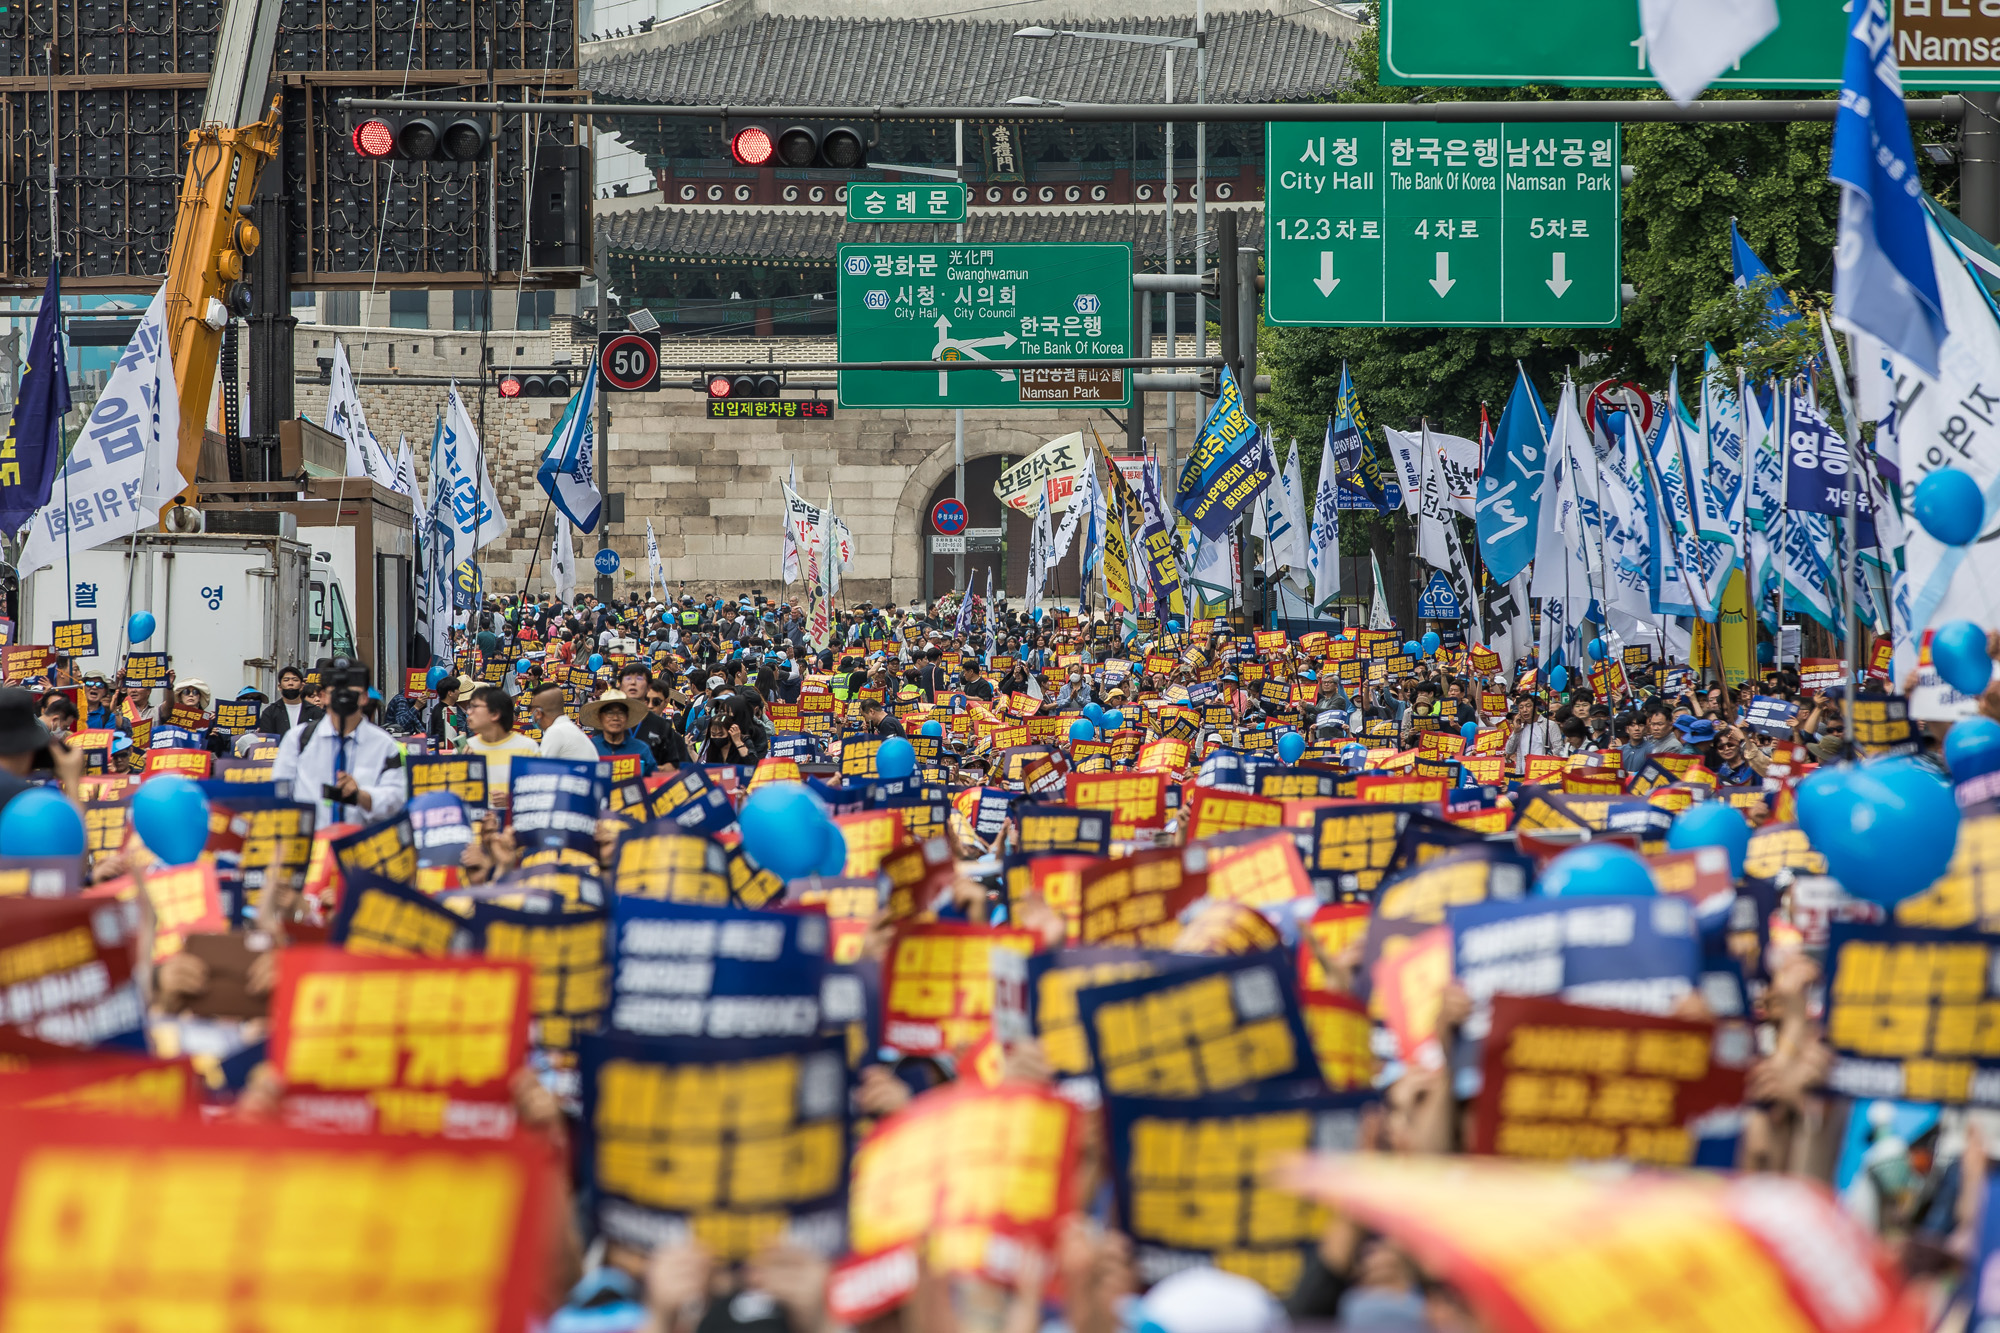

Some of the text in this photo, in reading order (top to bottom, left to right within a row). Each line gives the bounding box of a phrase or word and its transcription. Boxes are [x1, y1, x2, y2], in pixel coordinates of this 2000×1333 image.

[992, 125, 1014, 172] 崇禮門
[1300, 137, 1358, 166] 시청
[1390, 138, 1498, 167] 한국은행
[1506, 138, 1612, 168] 남산공원
[225, 156, 240, 209] KATO
[1281, 171, 1373, 193] City Hall
[1391, 172, 1496, 190] The Bank Of Korea
[1506, 173, 1611, 191] Namsan Park
[1530, 218, 1589, 239] 5차로
[850, 255, 938, 277] 50 광화문
[949, 250, 993, 265] 光化門
[947, 267, 1028, 283] Gwanghwamun
[868, 293, 884, 307] 60
[1079, 298, 1095, 311] 31
[895, 308, 938, 320] City Hall
[954, 308, 1015, 320] City Council
[1020, 316, 1102, 337] 한국은행
[1020, 342, 1123, 355] The Bank Of Korea
[615, 351, 644, 375] 50
[1022, 387, 1099, 399] Namsan Park
[712, 402, 828, 416] 진입제한차량 단속
